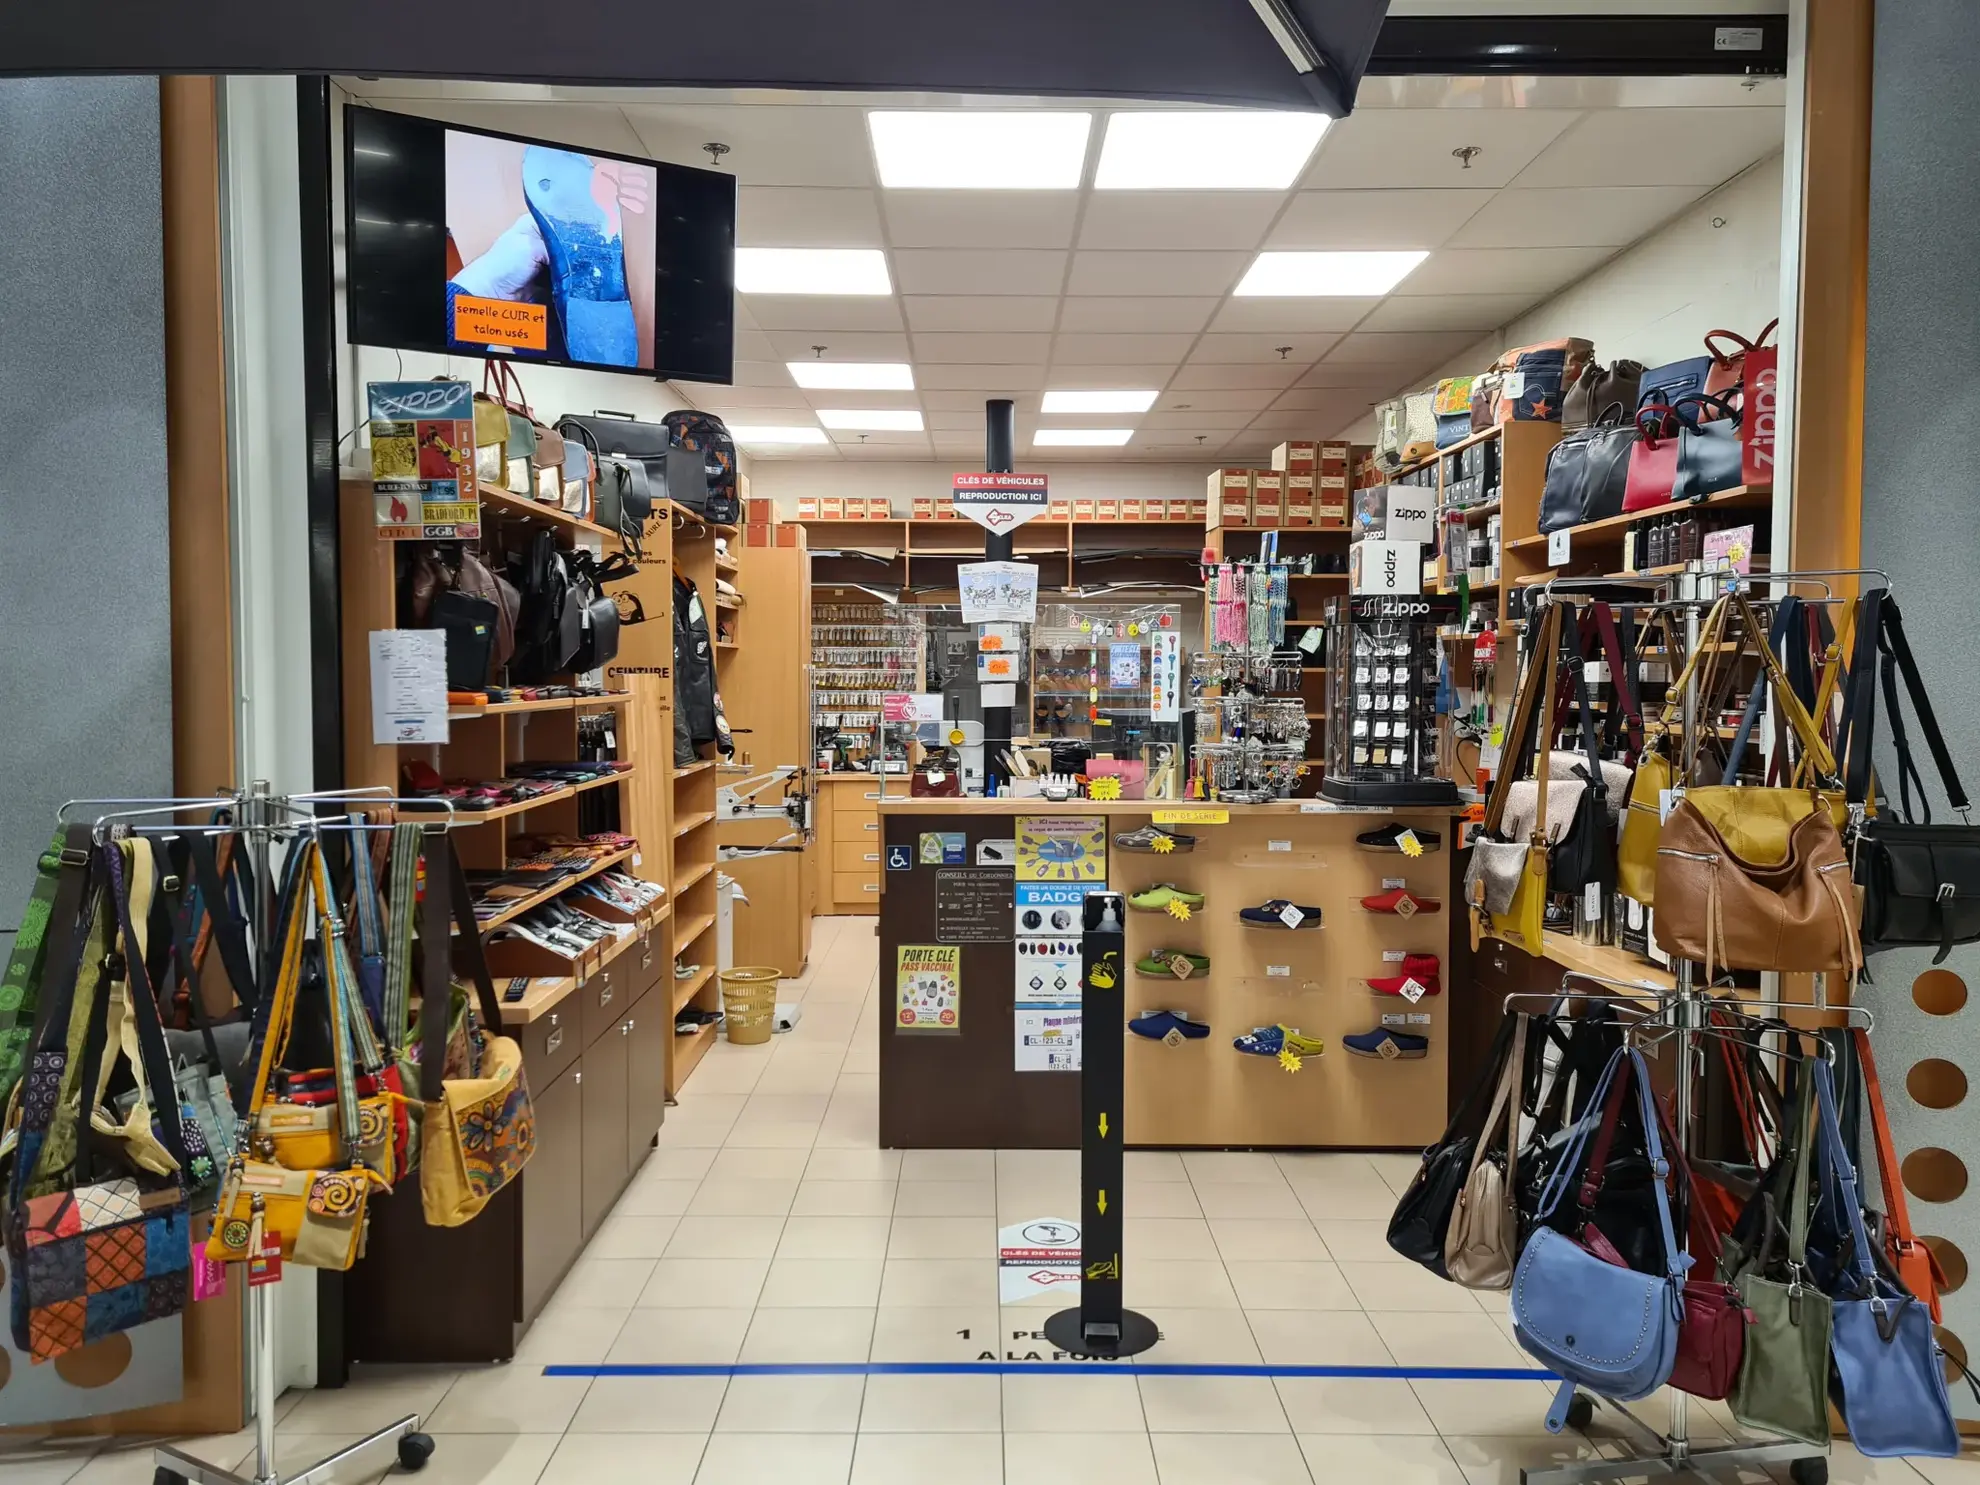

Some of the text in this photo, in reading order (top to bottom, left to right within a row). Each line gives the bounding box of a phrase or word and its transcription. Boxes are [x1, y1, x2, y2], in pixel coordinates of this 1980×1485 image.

[456, 305, 544, 323] semelle CUIR et
[473, 324, 529, 339] talon usés
[379, 385, 464, 415] ZIPPO
[957, 476, 980, 484] CLÉS
[996, 476, 1045, 486] VÉHICULES
[959, 492, 1028, 501] REPRODUCTION
[1395, 508, 1426, 521] zippo
[1363, 530, 1384, 540] zippo
[1384, 549, 1396, 588] zippo
[1383, 602, 1430, 617] zippo
[608, 667, 669, 678] CEINTURE
[1163, 812, 1177, 820] FIN
[1180, 812, 1191, 820] DE
[1028, 891, 1083, 903] BADG
[903, 947, 956, 962] PORTE CLÉ
[900, 962, 955, 972] PASS VACCINAL
[1043, 1017, 1062, 1027] Plaque
[1062, 1015, 1082, 1026] minér
[956, 1329, 971, 1340] 1
[977, 1351, 996, 1361] A
[1007, 1351, 1043, 1361] LA
